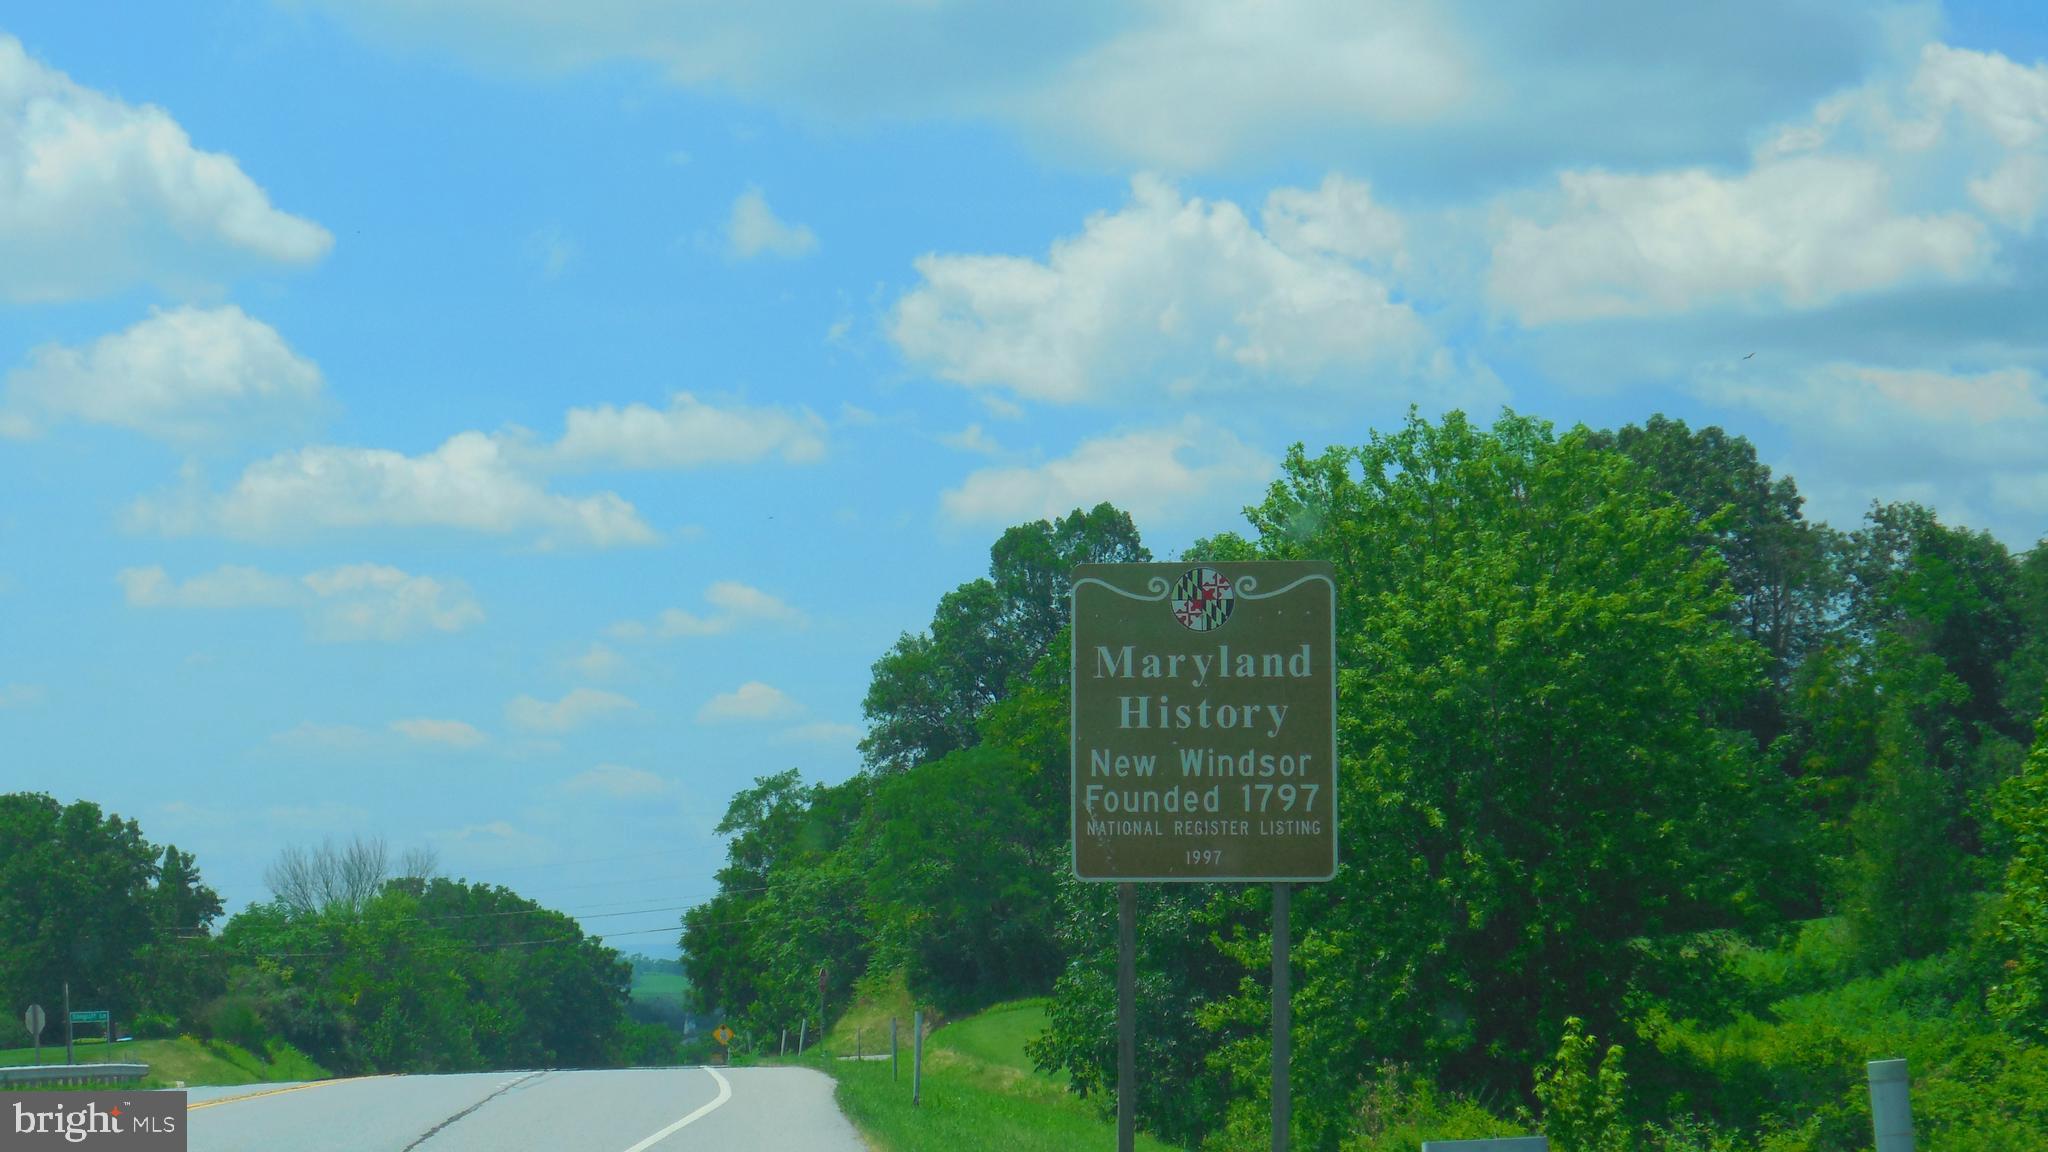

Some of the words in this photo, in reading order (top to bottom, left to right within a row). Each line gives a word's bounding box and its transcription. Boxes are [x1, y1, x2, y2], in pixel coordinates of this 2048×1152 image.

[1093, 644, 1312, 688] Maryland
[1117, 696, 1289, 738] History
[1091, 749, 1157, 777] New
[1180, 749, 1312, 777] Windsor
[1086, 785, 1220, 813] Founded
[1242, 784, 1320, 813] 1797
[1087, 820, 1163, 836] NATIONAL
[1174, 820, 1249, 836] REGISTER
[1260, 820, 1321, 836] LISTING
[1185, 850, 1222, 865] 1997
